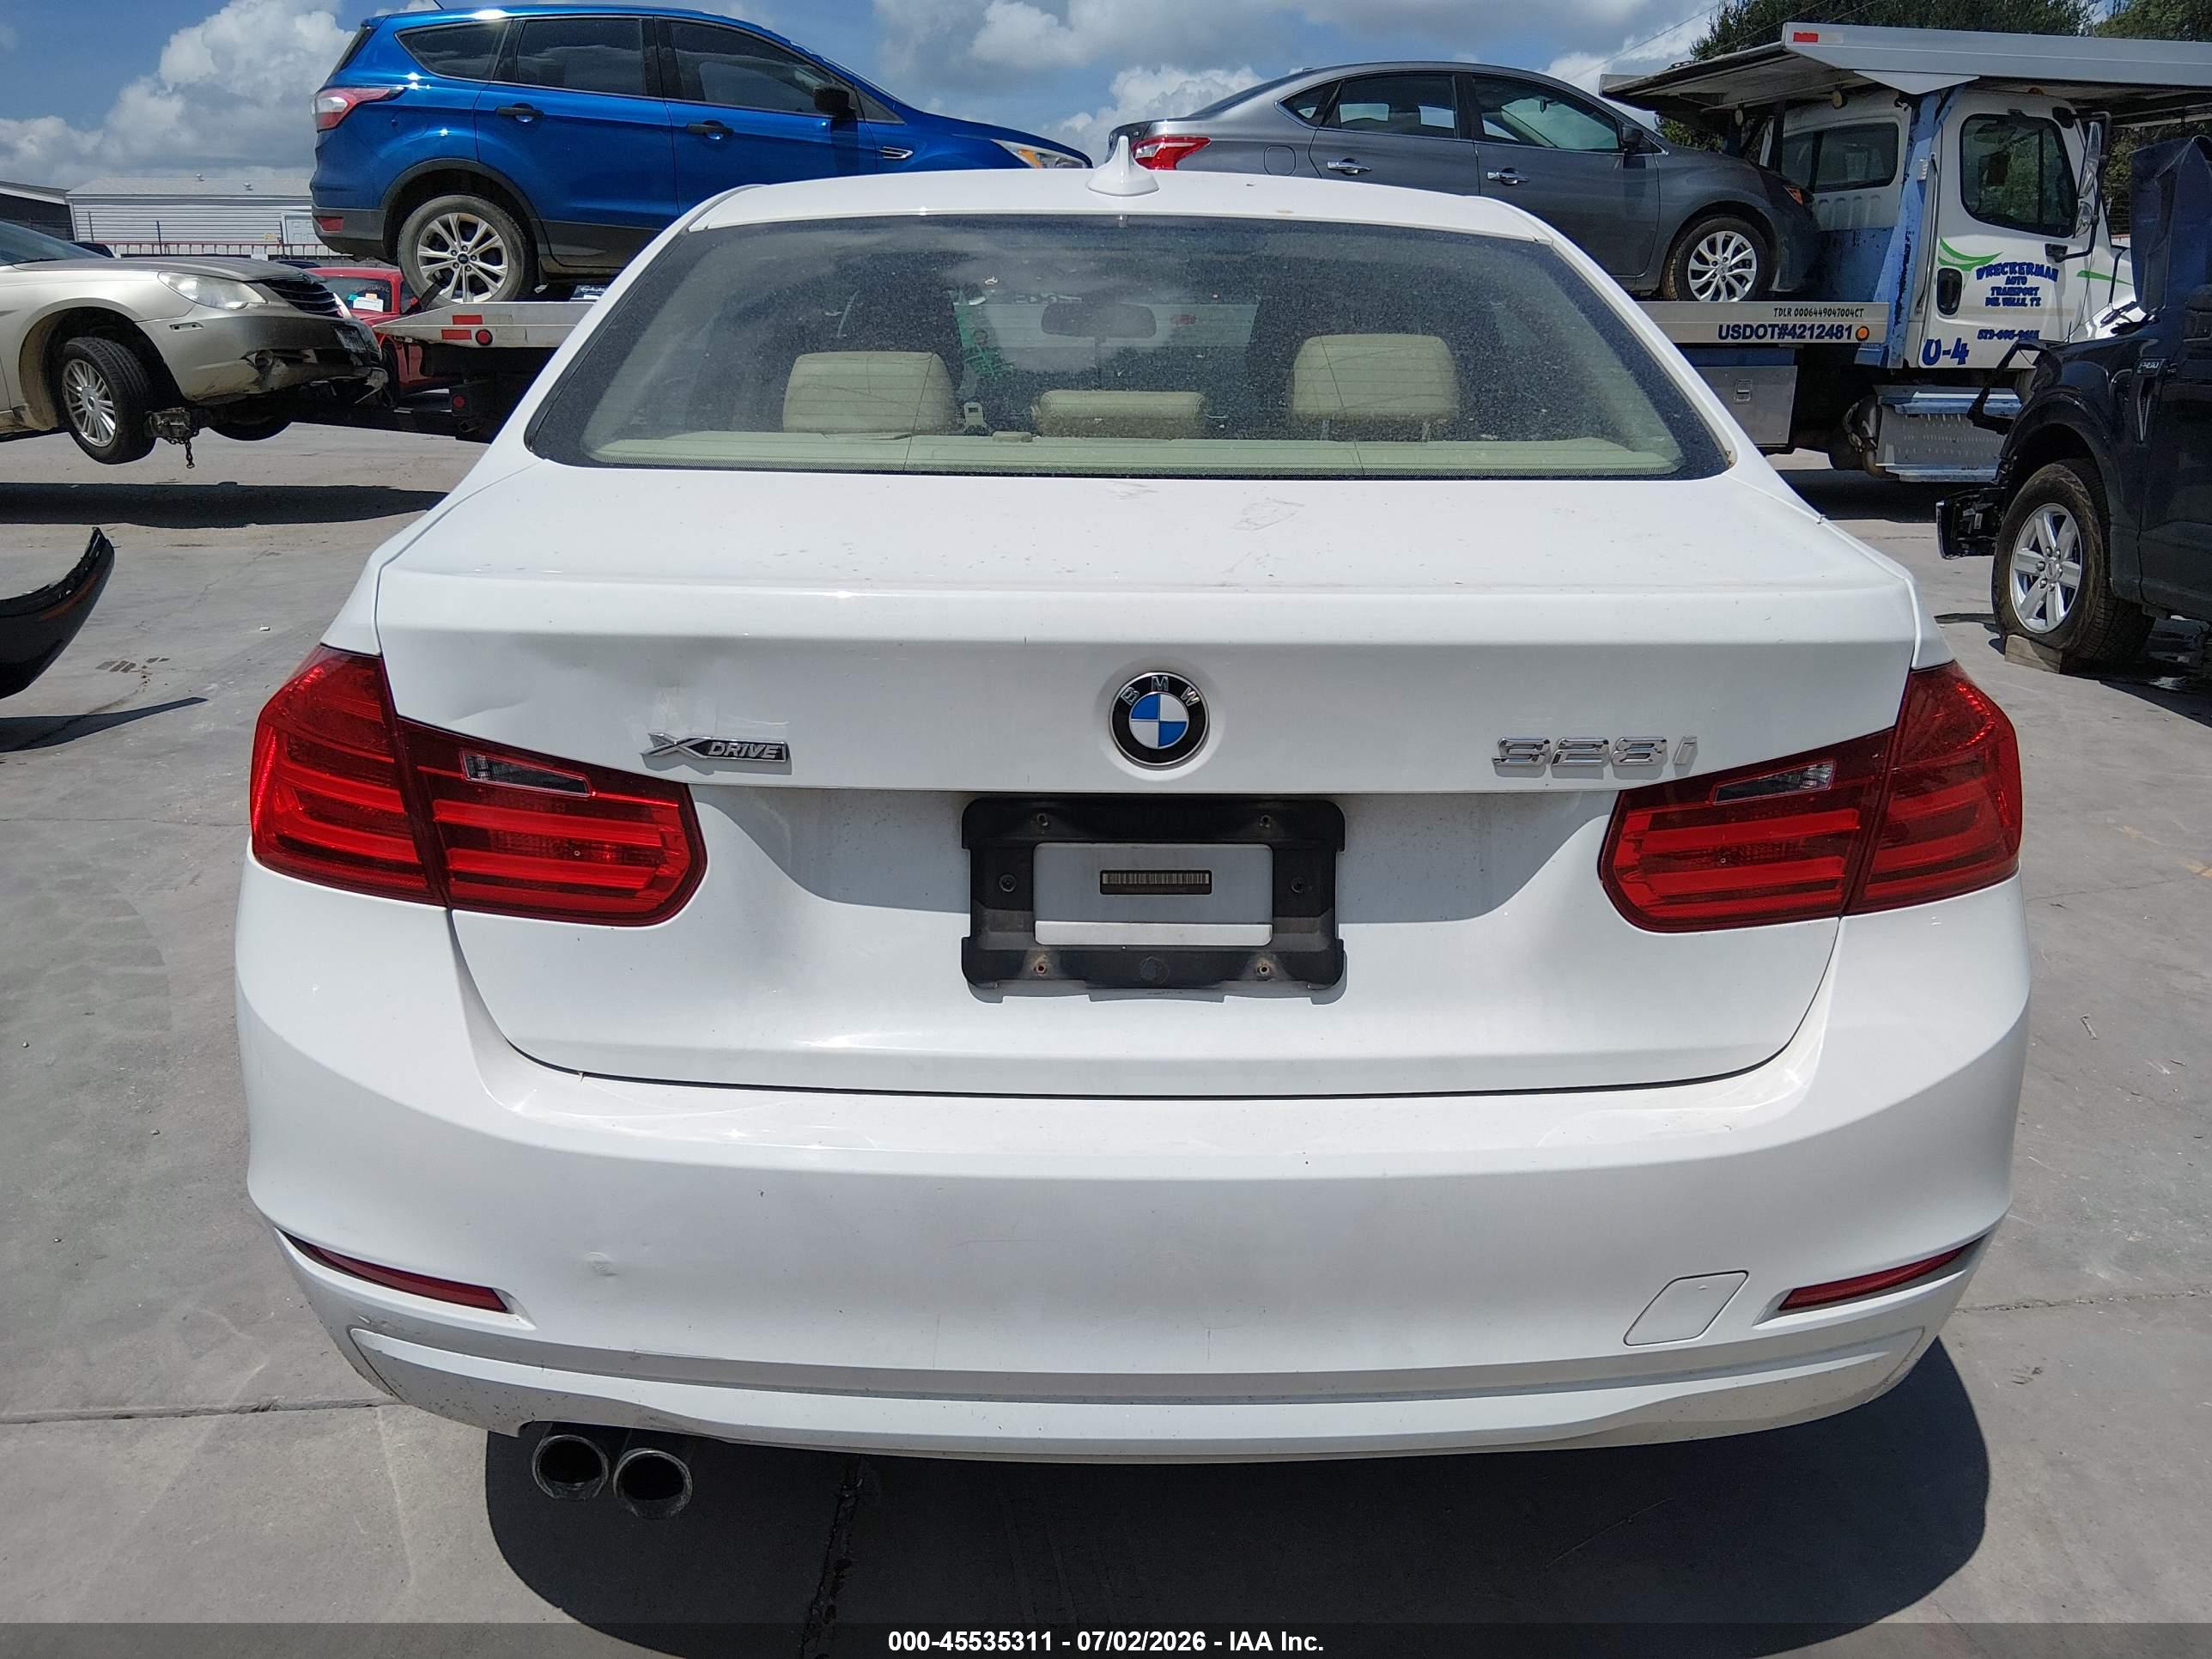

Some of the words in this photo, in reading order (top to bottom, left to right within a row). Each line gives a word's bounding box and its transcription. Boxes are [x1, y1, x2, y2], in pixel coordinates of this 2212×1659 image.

[1976, 262, 2059, 283] WRECKERMAN
[1773, 307, 1792, 318] TDLR
[1718, 323, 1853, 340] USDOT#4212481
[1922, 337, 1970, 366] U-4
[1120, 675, 1200, 707] BMW
